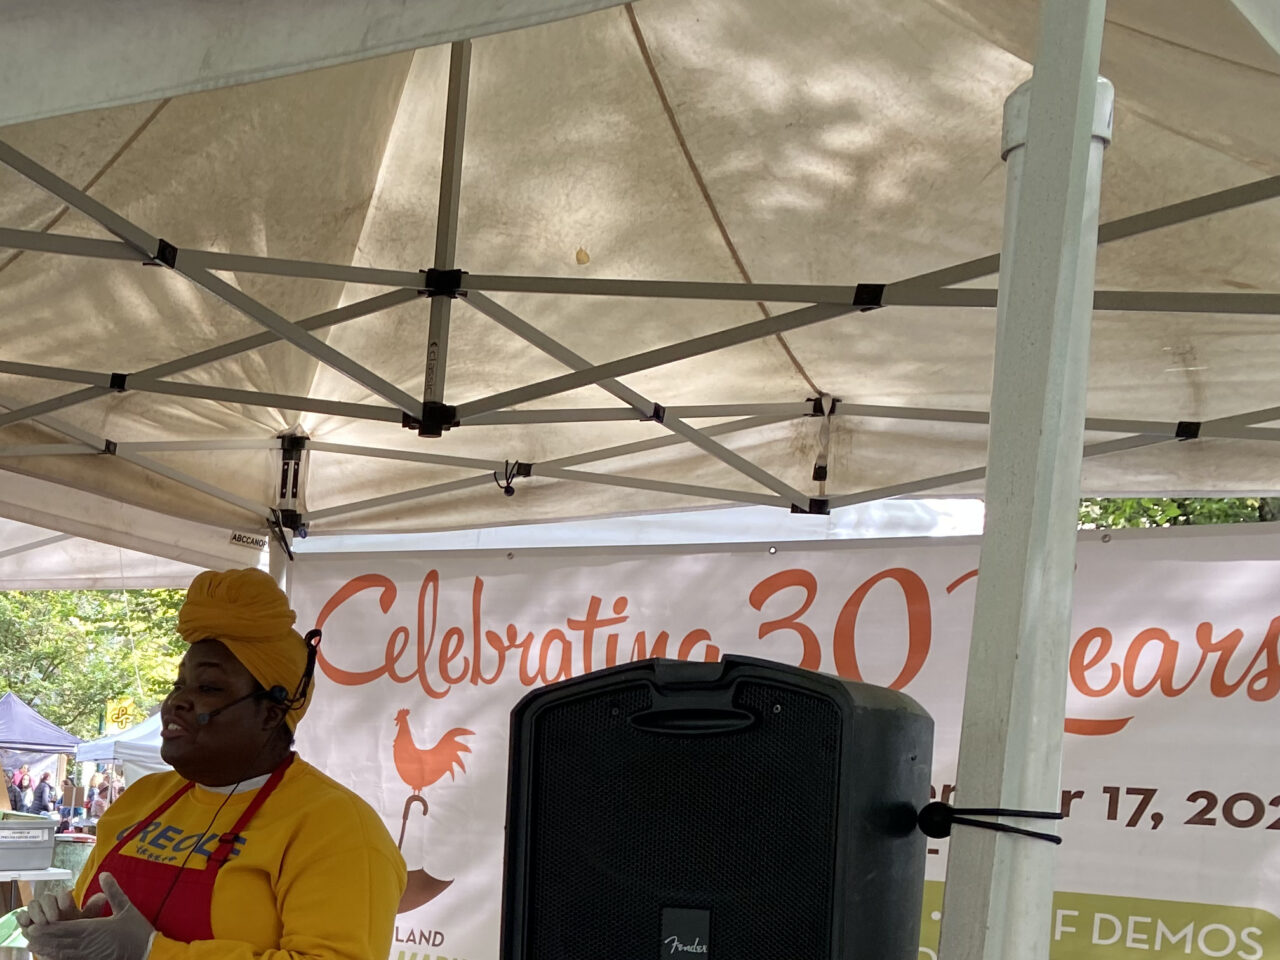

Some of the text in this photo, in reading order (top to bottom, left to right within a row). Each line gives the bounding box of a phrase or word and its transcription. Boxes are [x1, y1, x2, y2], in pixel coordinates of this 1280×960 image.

[748, 567, 933, 692] 30
[1102, 786, 1165, 830] 17,
[395, 926, 445, 948] LAND
[664, 935, 708, 954] Fender
[1091, 912, 1264, 960] DEMOS
